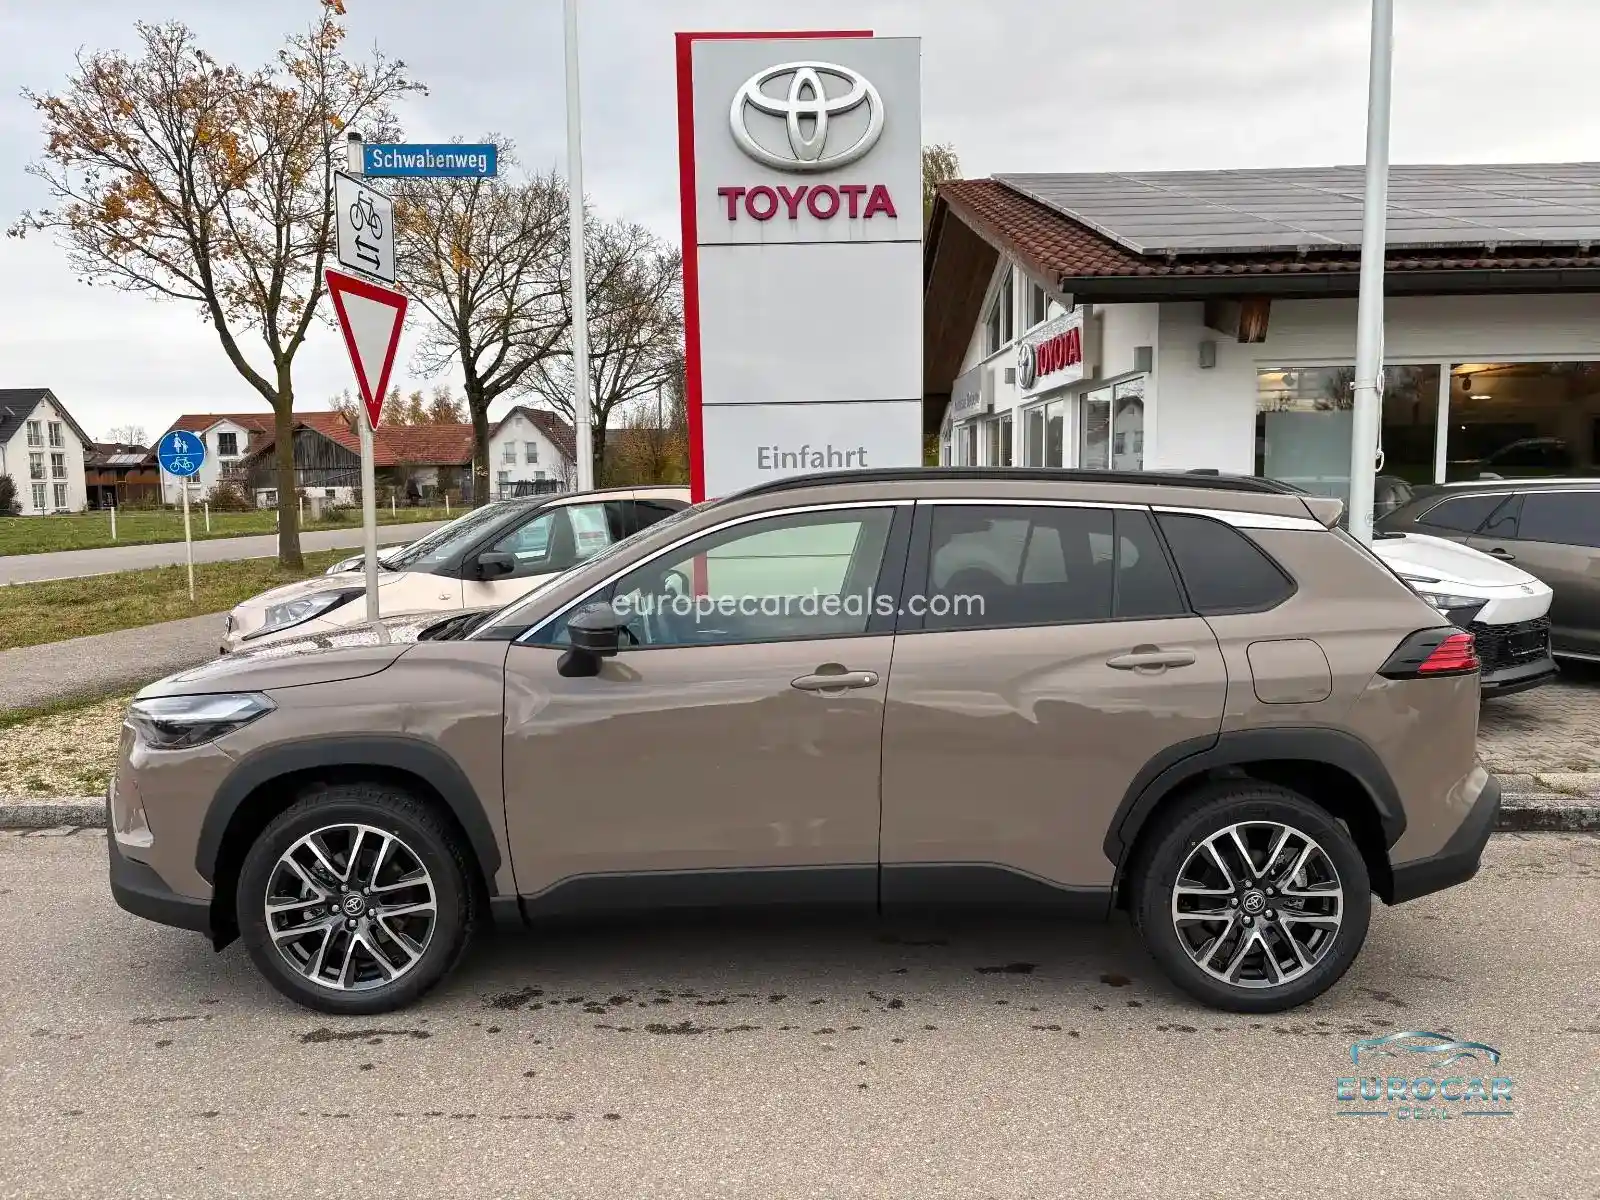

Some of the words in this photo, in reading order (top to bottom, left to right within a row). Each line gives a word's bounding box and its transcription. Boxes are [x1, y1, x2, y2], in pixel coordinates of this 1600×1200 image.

[372, 149, 488, 173] Schwabenweg
[718, 184, 898, 221] TOYOTA
[1035, 326, 1082, 378] TOYOTA
[757, 444, 868, 470] Einfahrt
